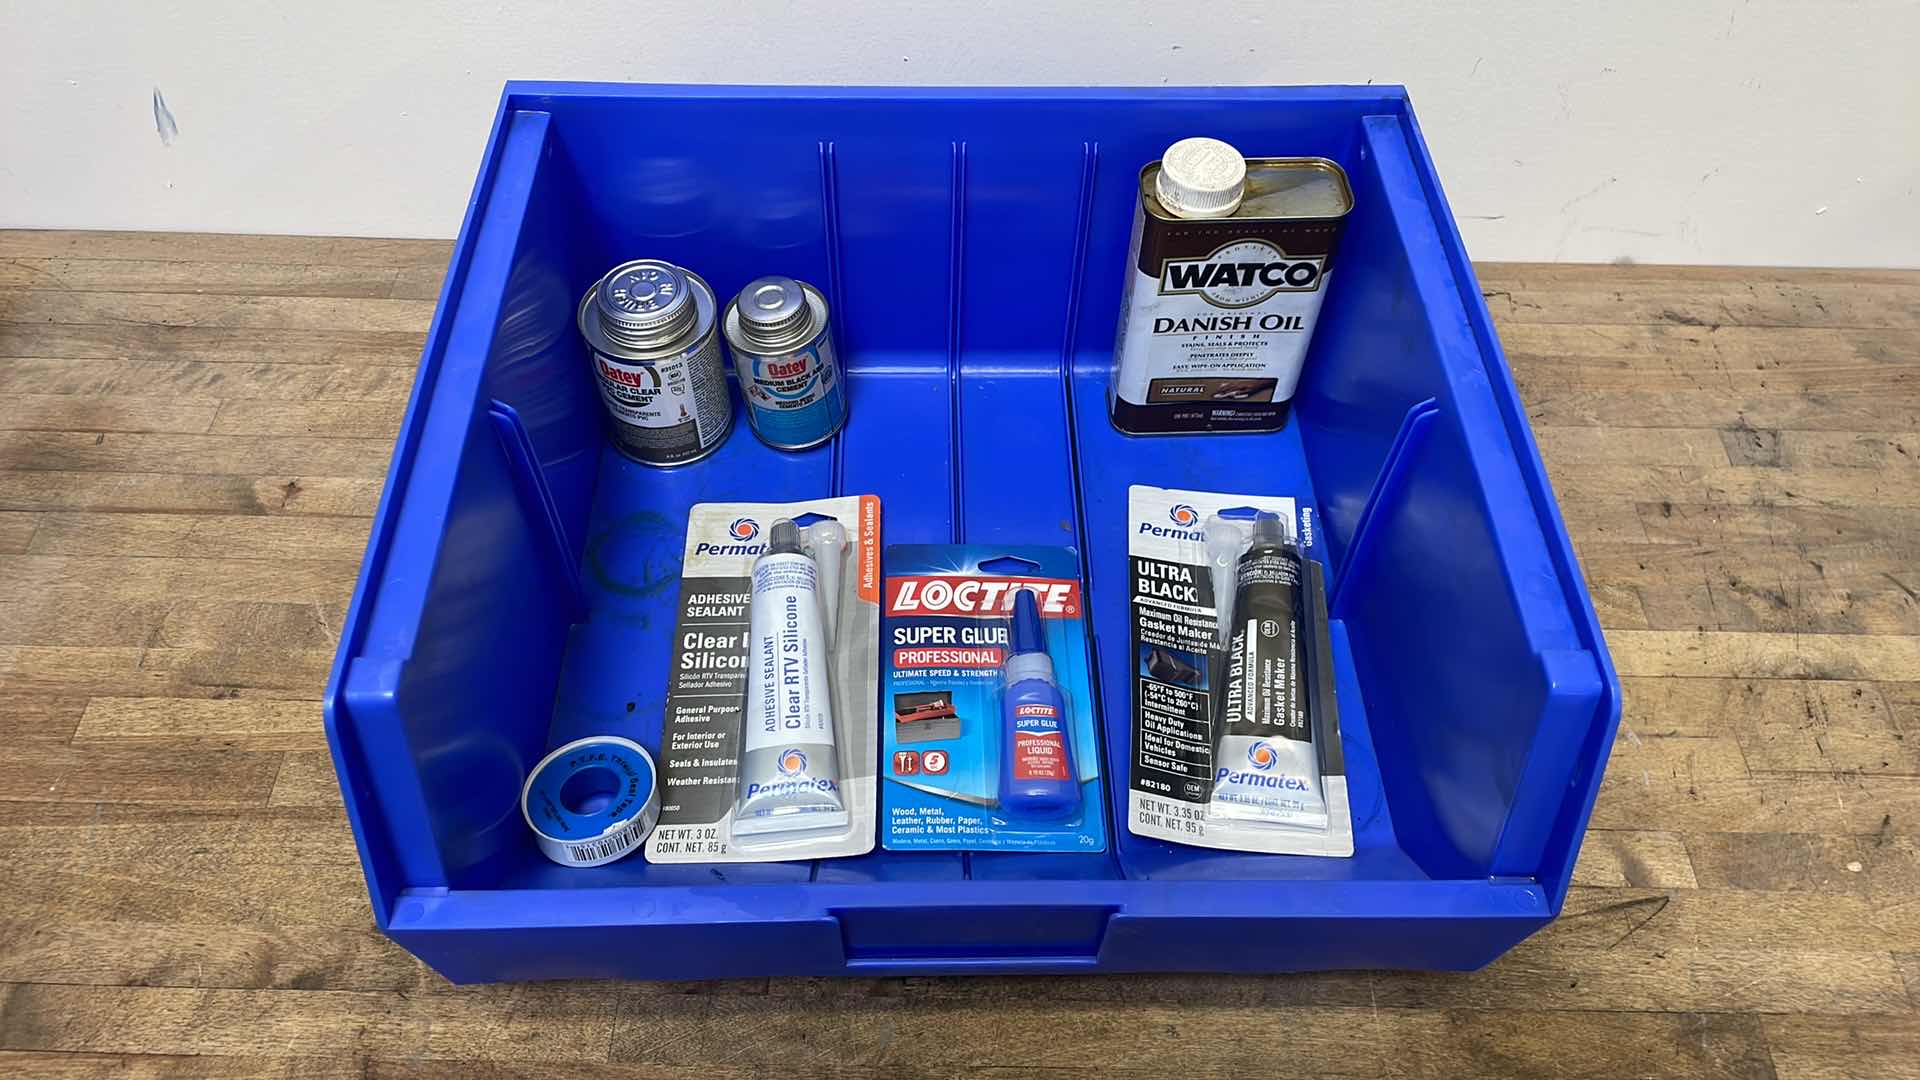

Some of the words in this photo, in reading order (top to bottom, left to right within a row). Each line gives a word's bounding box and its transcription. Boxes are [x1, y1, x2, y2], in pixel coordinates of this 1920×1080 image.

[1168, 261, 1318, 289] WATCO
[1153, 315, 1254, 334] DANISH
[1259, 314, 1305, 331] OIL
[599, 360, 642, 387] Oatey
[768, 358, 807, 377] Oatey
[1160, 386, 1207, 394] NATURAL
[864, 501, 875, 537] Sealants
[1302, 507, 1313, 547] Gasketing
[1139, 522, 1205, 543] Permat
[696, 543, 768, 556] Permat
[863, 544, 874, 589] Adhesives
[1138, 560, 1193, 584] ULTRA
[1138, 578, 1198, 602] BLACK
[688, 593, 751, 605] ADHESIVE
[687, 606, 745, 617] SEALANT
[1139, 606, 1171, 621] Maximum
[1173, 613, 1183, 624] Oil
[783, 595, 797, 652] Silicone
[1139, 617, 1176, 634] Gasket
[1178, 625, 1213, 640] Maker
[683, 632, 738, 649] Clear
[894, 628, 956, 644] SUPER
[763, 634, 774, 679] SEALANT
[899, 651, 999, 664] PROFESSIONAL
[1229, 634, 1244, 676] BLACK
[784, 657, 800, 685] RTV
[893, 670, 927, 678] ULTIMATE
[961, 669, 998, 677] STRENGTH
[1275, 658, 1286, 689] Maker
[1165, 686, 1173, 695] to
[1167, 694, 1174, 704] to
[764, 682, 775, 732] ADHESIVE
[1145, 699, 1186, 716] Intermittent
[1226, 678, 1243, 723] ULTRA
[1274, 692, 1285, 726] Gasket
[675, 706, 706, 714] General
[784, 690, 800, 729] Clear
[1020, 707, 1053, 715] LOCTITE
[1262, 697, 1271, 725] Maximum
[675, 715, 711, 723] Adhesive
[1017, 720, 1040, 728] SUPER
[1145, 711, 1167, 726] Heavy
[1168, 717, 1185, 730] Duty
[672, 732, 685, 741] For
[687, 732, 716, 740] Interior
[1145, 720, 1155, 730] Oil
[1156, 723, 1203, 741] Applications
[671, 742, 702, 750] Exterior
[704, 740, 720, 748] Use
[1027, 747, 1053, 755] LIQUID
[1145, 733, 1162, 744] Ideal
[1163, 737, 1174, 747] for
[1175, 740, 1210, 754] Domestic
[1145, 742, 1176, 757] Vehicles
[669, 760, 691, 768] Seals
[693, 759, 700, 767] &
[929, 755, 939, 764] 5
[1144, 755, 1170, 768] Sensor
[1171, 761, 1188, 773] Safe
[667, 777, 701, 786] Weather
[1186, 784, 1200, 792] OEM
[1216, 768, 1304, 791] Permatex
[892, 808, 917, 816] Wood,
[919, 808, 944, 816] Metal,
[1139, 799, 1156, 812] NET
[1174, 805, 1192, 818] 3.35
[892, 817, 924, 825] Leather,
[926, 817, 956, 825] Rubber,
[957, 817, 983, 827] Paper,
[892, 826, 925, 834] Ceramic
[927, 826, 934, 834] &
[936, 825, 956, 834] Most
[957, 826, 989, 834] Plastics
[1139, 812, 1163, 827] CONT.
[1185, 821, 1197, 833] 95
[658, 829, 676, 840] NET
[696, 828, 703, 839] 3
[1079, 834, 1095, 846] 20g
[656, 842, 682, 853] CONT.
[707, 841, 719, 852] 85
